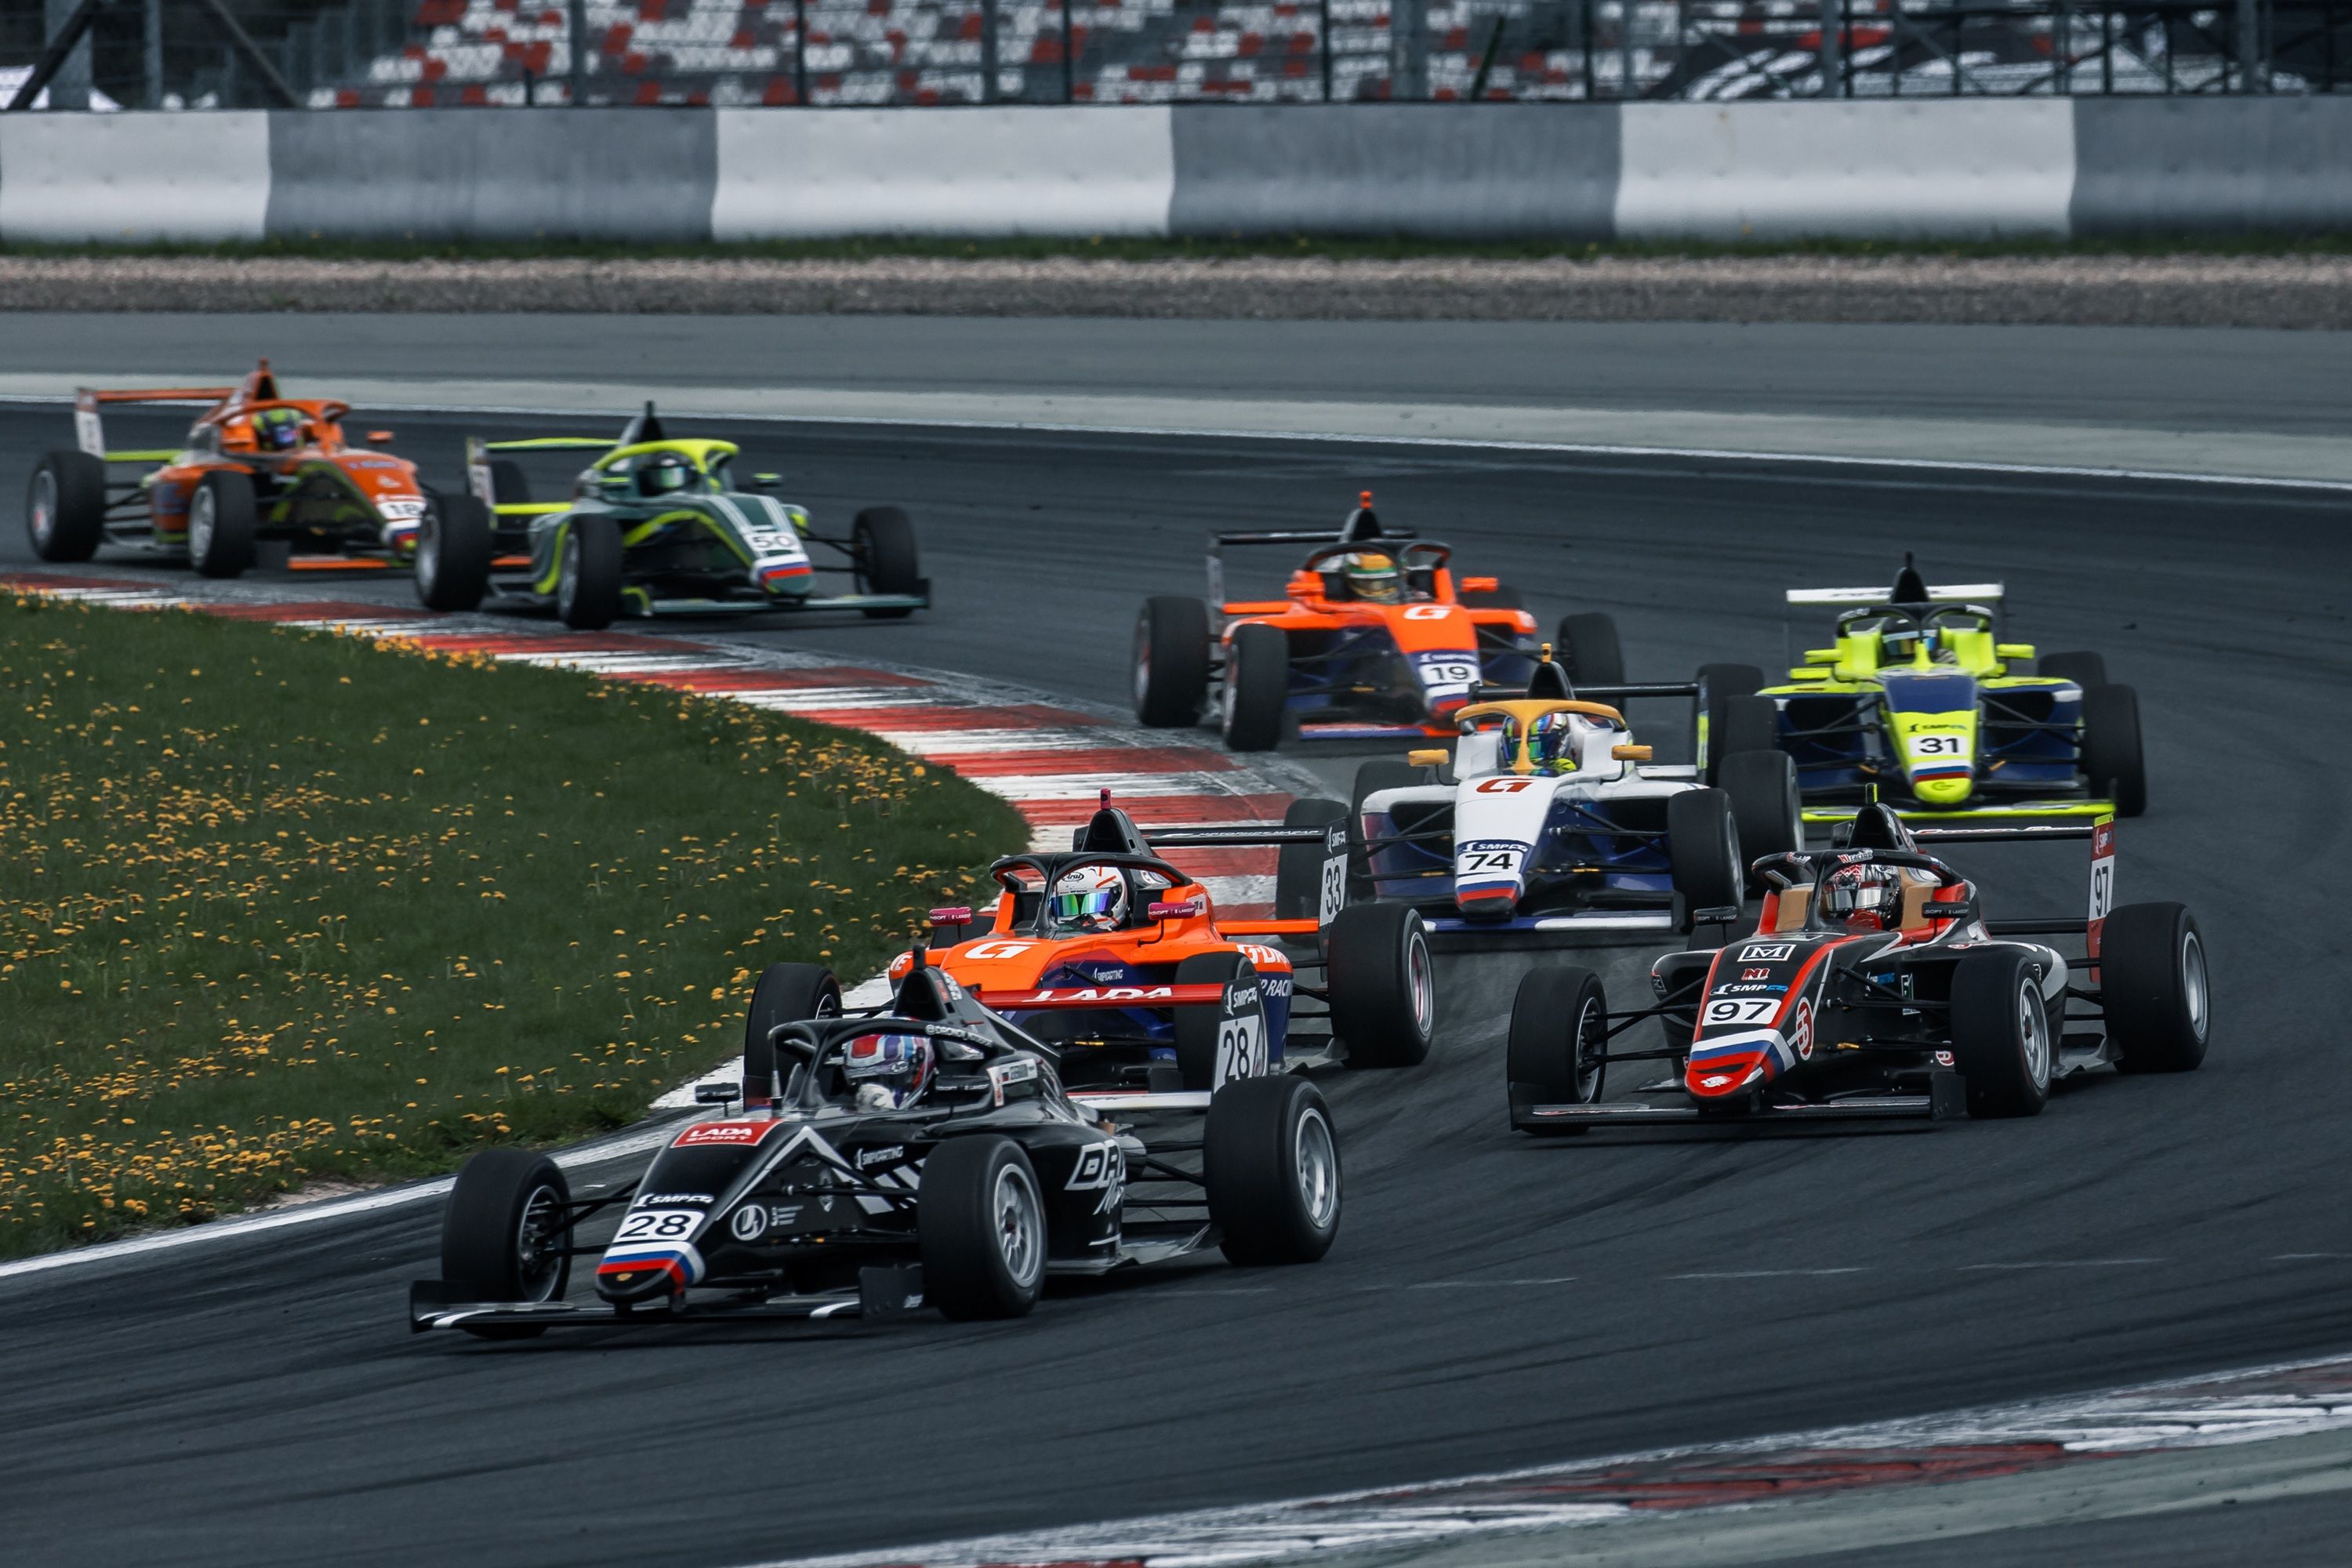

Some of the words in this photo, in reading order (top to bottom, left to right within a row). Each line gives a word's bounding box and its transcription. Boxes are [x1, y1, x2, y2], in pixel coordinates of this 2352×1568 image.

[752, 535, 796, 548] 50
[1430, 666, 1468, 681] 19
[1919, 738, 1958, 753] 31
[1465, 853, 1513, 871] 74
[1326, 864, 1341, 916] 33
[2095, 866, 2108, 917] 97
[1022, 987, 1172, 1002] LADA
[1711, 1002, 1773, 1021] 97
[1223, 1027, 1250, 1080] 28
[690, 1127, 753, 1137] LADA
[619, 1214, 691, 1238] 28
